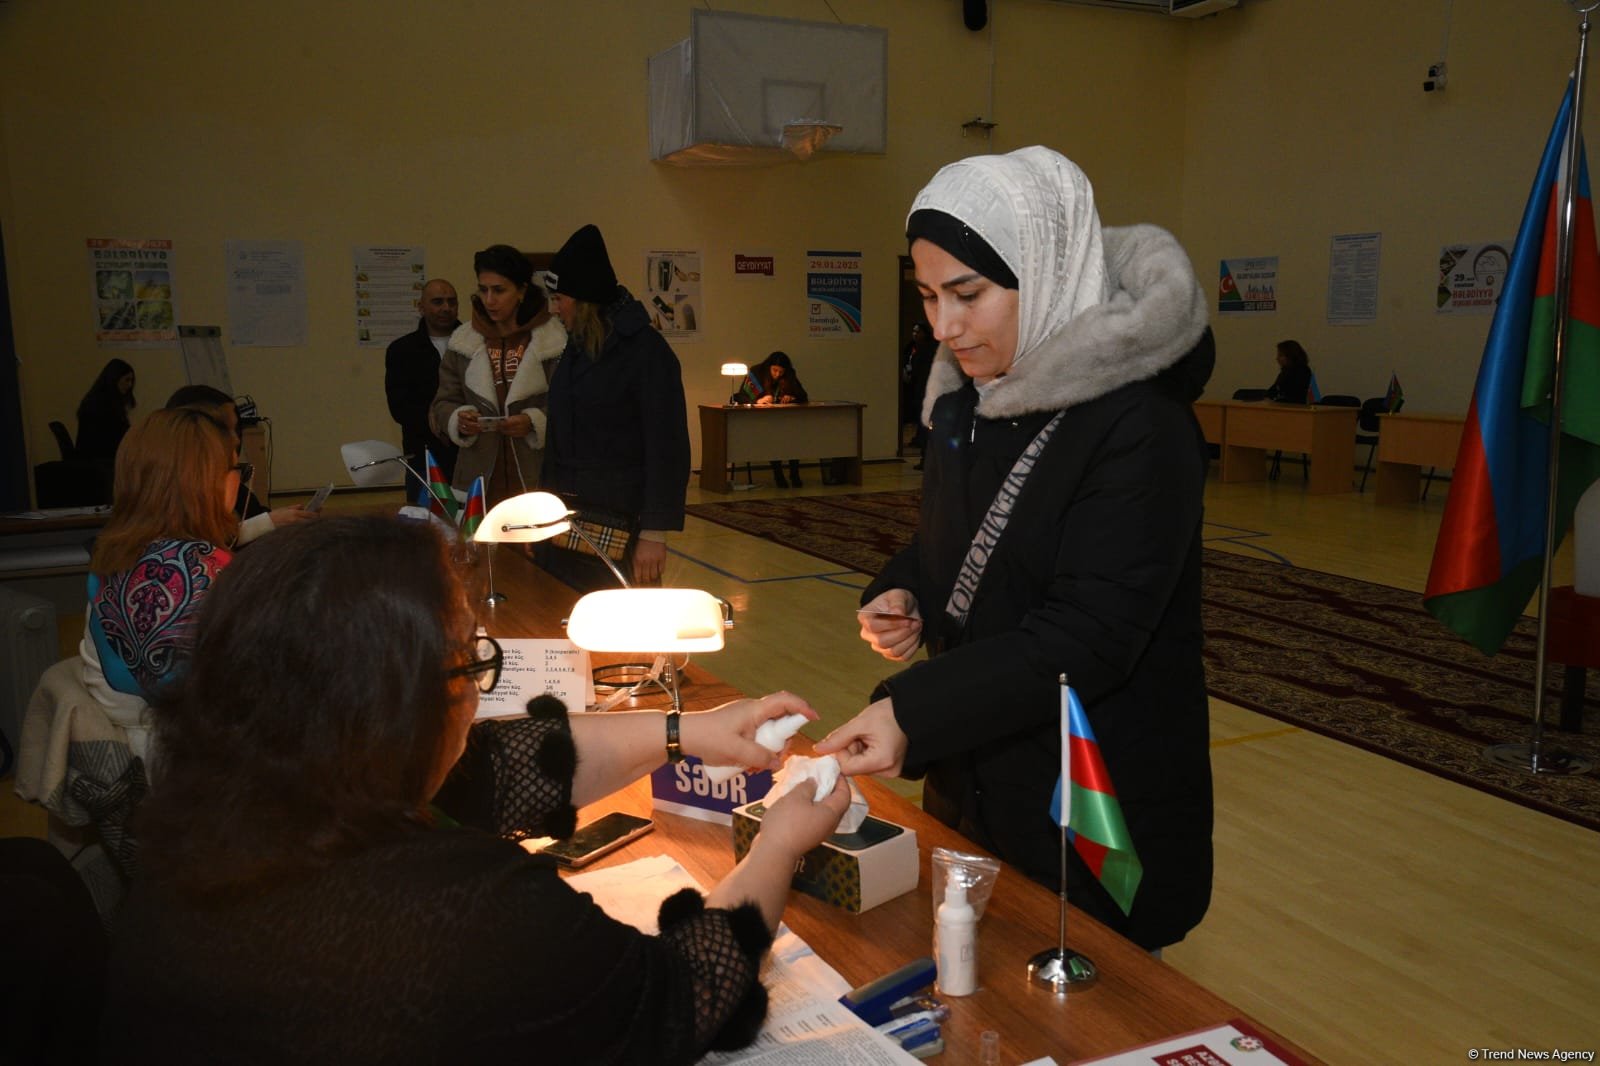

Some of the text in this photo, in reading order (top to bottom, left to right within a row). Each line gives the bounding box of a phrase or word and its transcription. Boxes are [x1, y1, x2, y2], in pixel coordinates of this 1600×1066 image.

[737, 260, 773, 270] QEYDİYYAT
[811, 260, 858, 269] 29.01.2025
[951, 486, 1017, 616] EMPORIO
[675, 760, 748, 805] SƏDR
